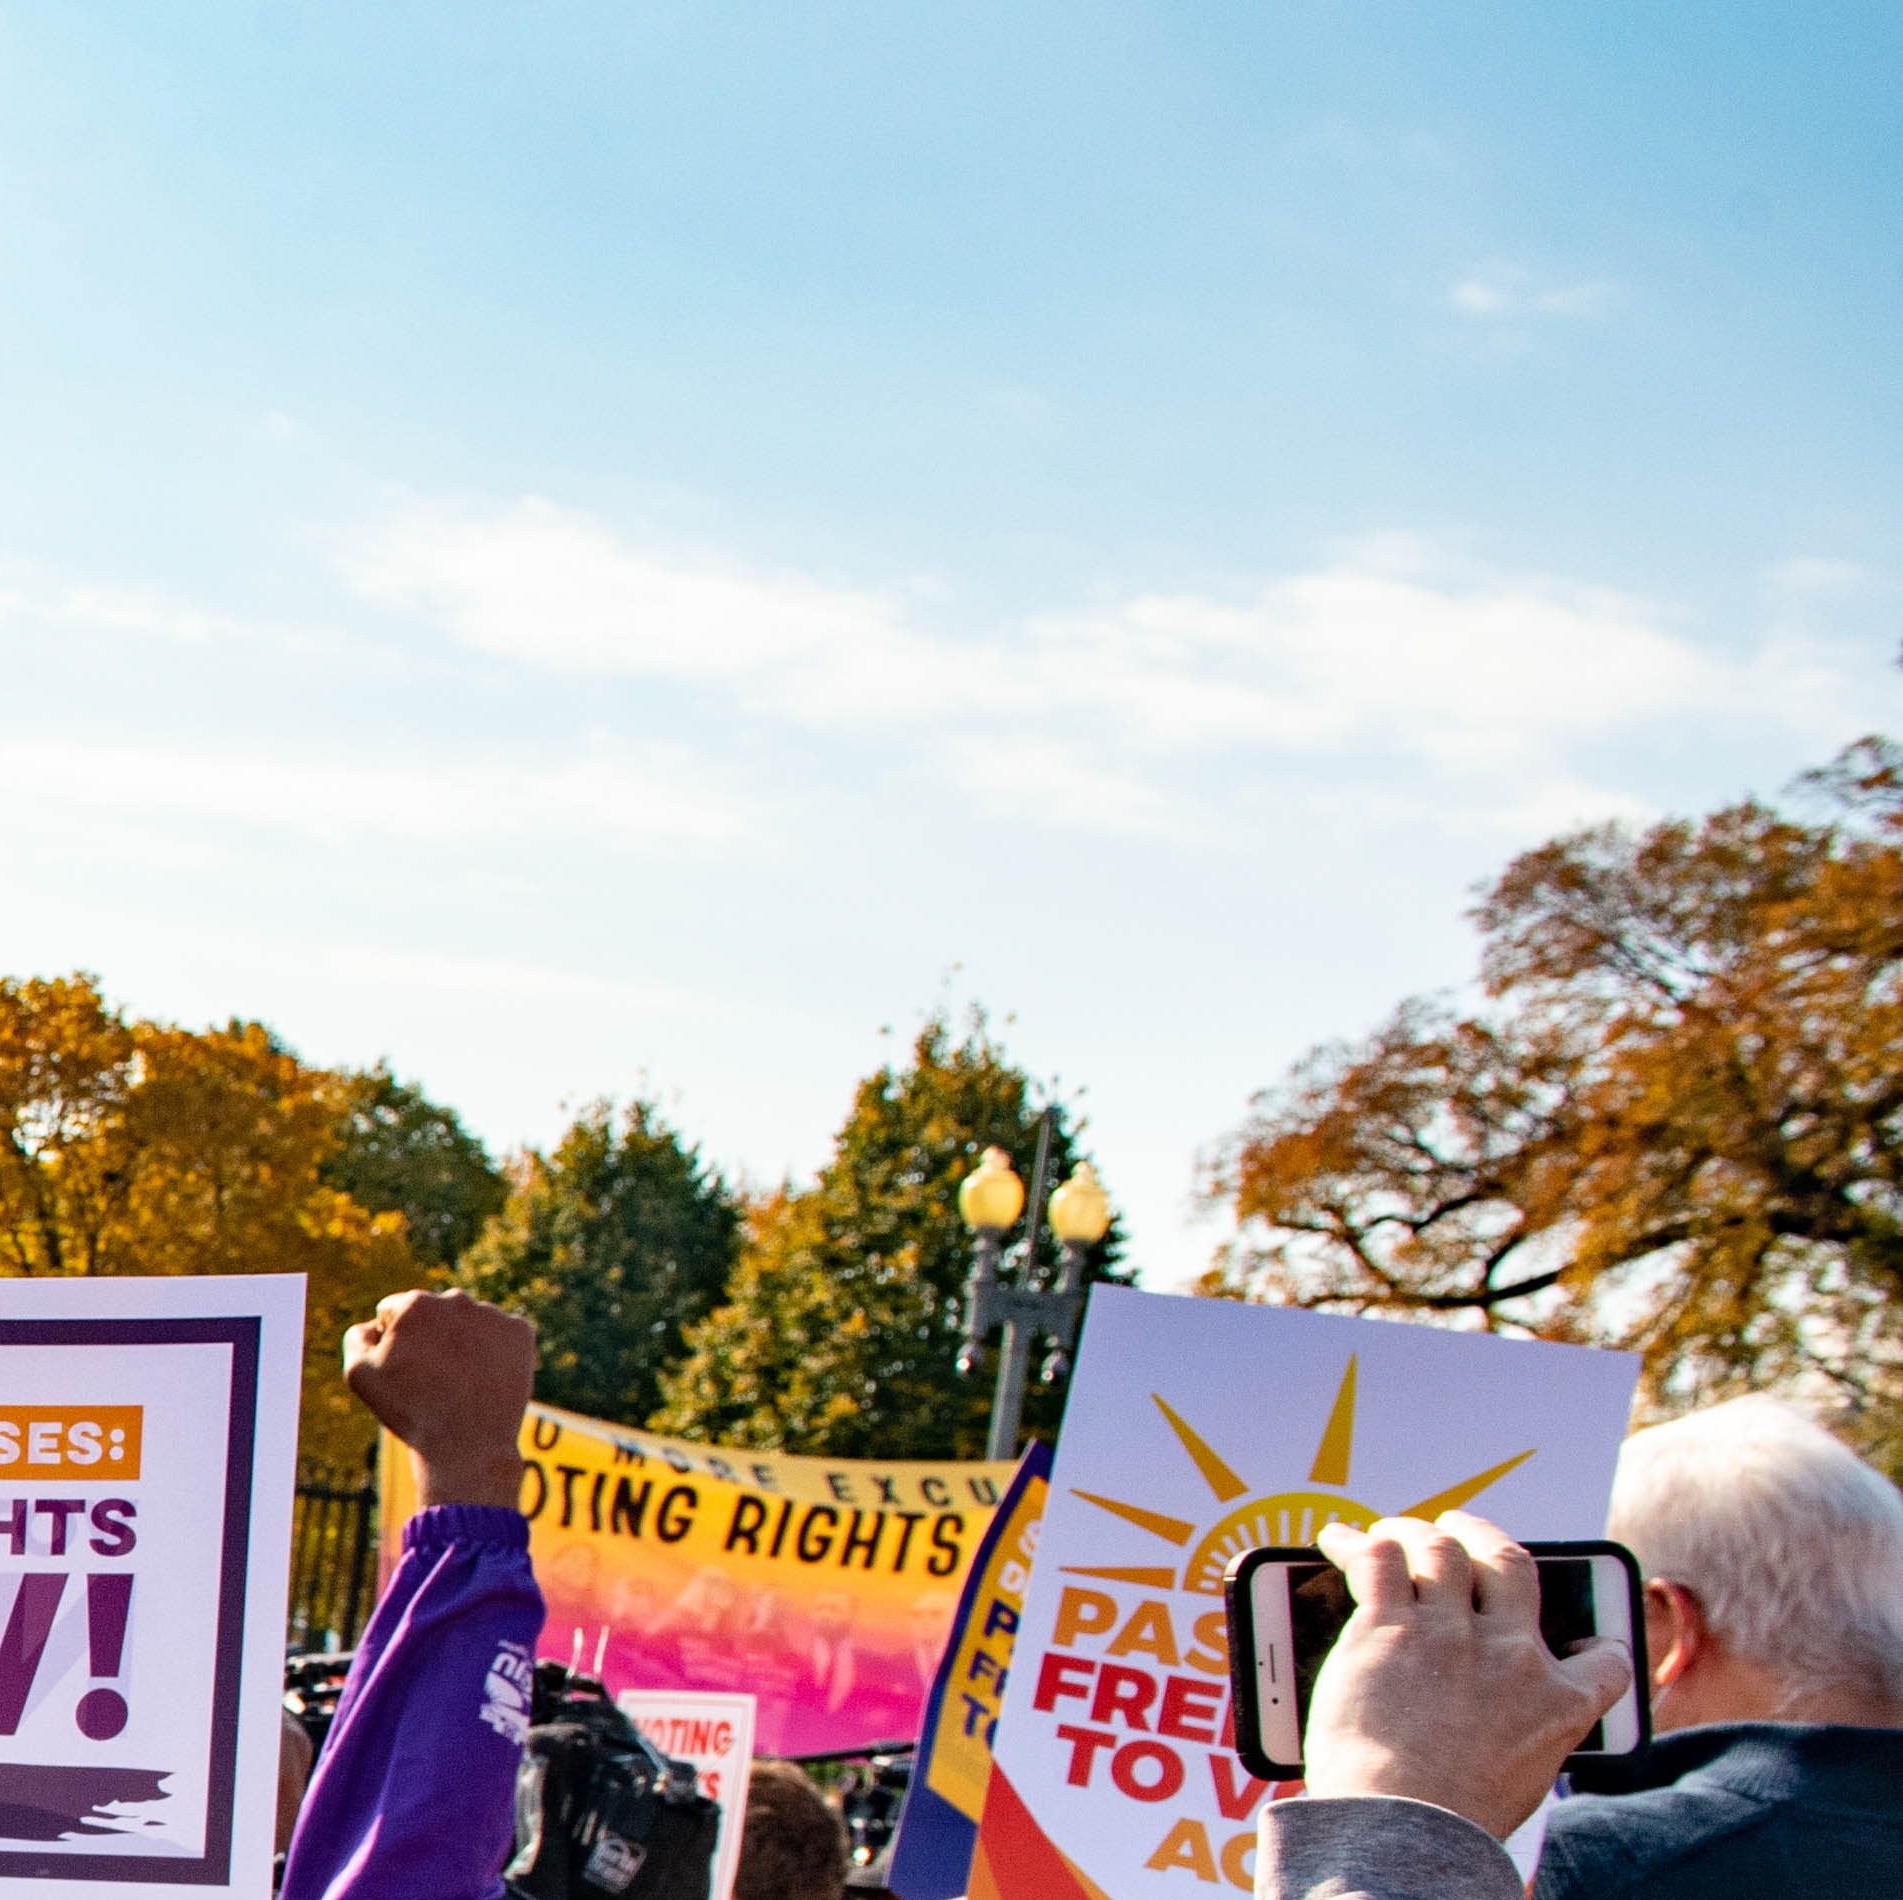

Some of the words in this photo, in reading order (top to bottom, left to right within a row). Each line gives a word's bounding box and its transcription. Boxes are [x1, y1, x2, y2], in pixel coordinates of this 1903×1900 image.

[520, 1460, 699, 1543] OTING
[724, 1493, 967, 1578] RIGHTS
[827, 1471, 999, 1508] EXCU
[1052, 1586, 1231, 1676] PAS
[1056, 1724, 1185, 1803] TO
[1144, 1818, 1257, 1894] AC
